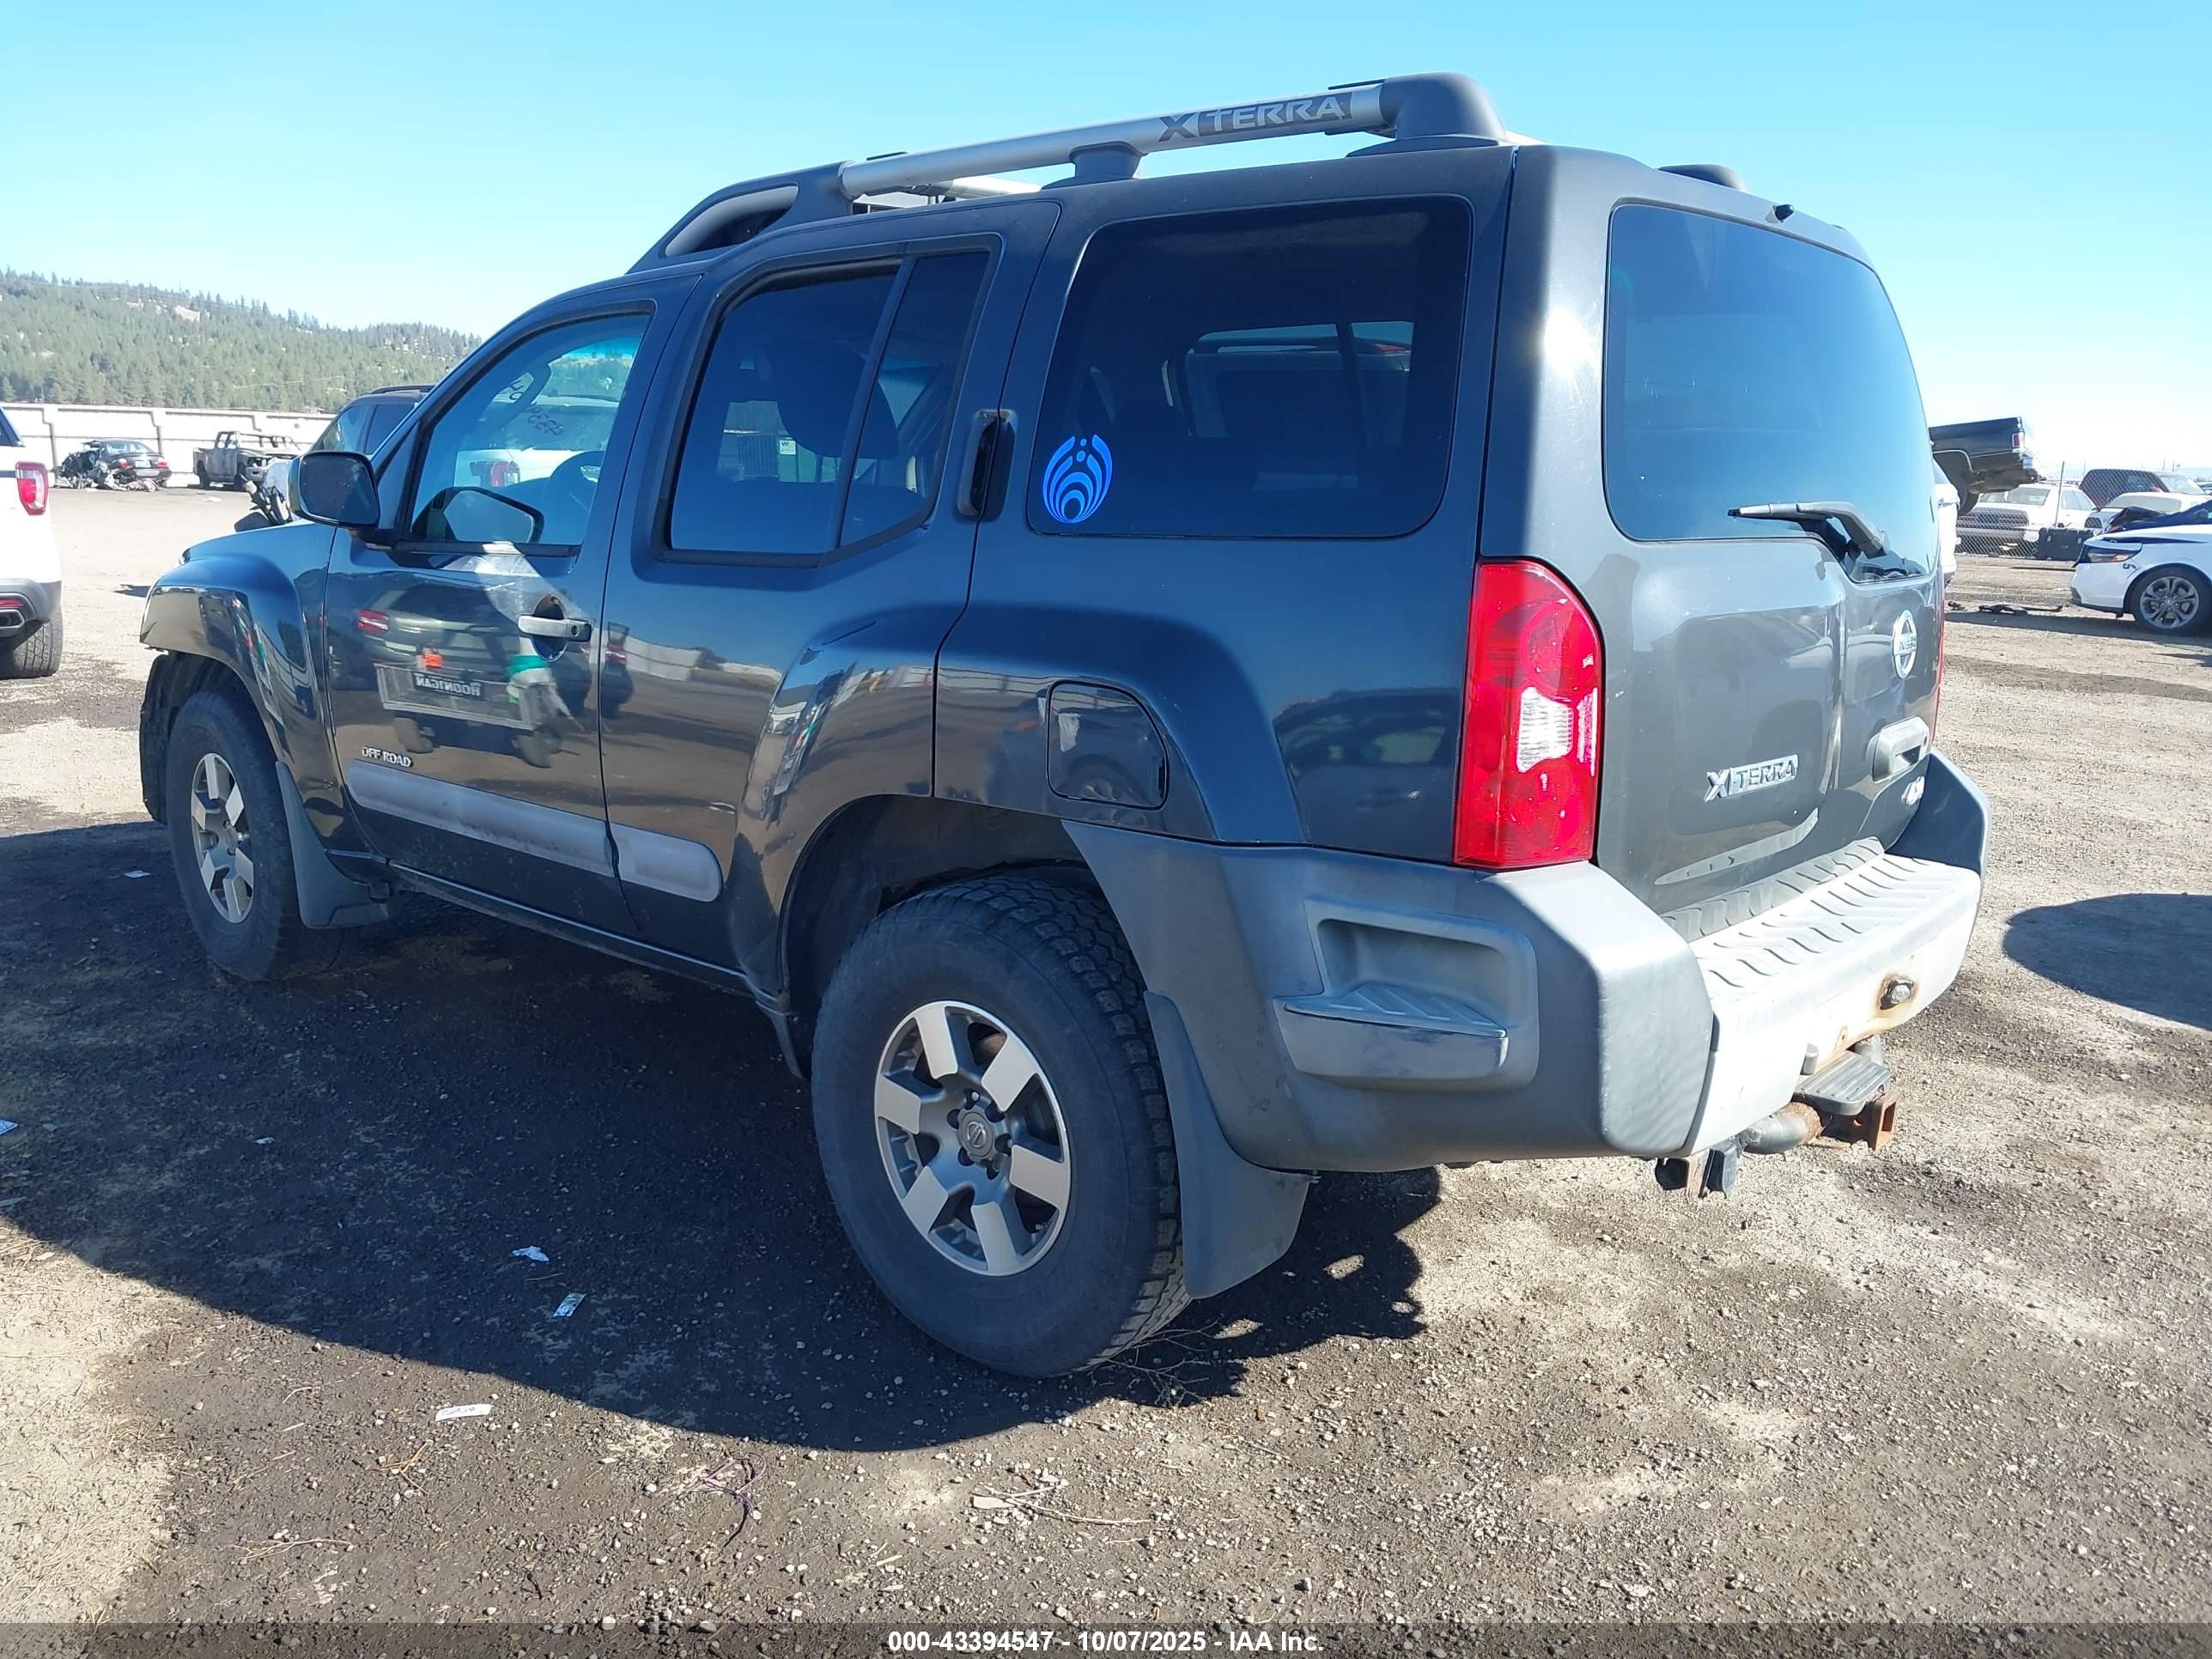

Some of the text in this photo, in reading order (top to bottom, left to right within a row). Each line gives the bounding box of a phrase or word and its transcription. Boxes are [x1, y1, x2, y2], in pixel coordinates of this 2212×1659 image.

[1158, 94, 1346, 142] XTERRA
[362, 746, 412, 768] OFF ROAD
[1704, 755, 1799, 803] XTERRA
